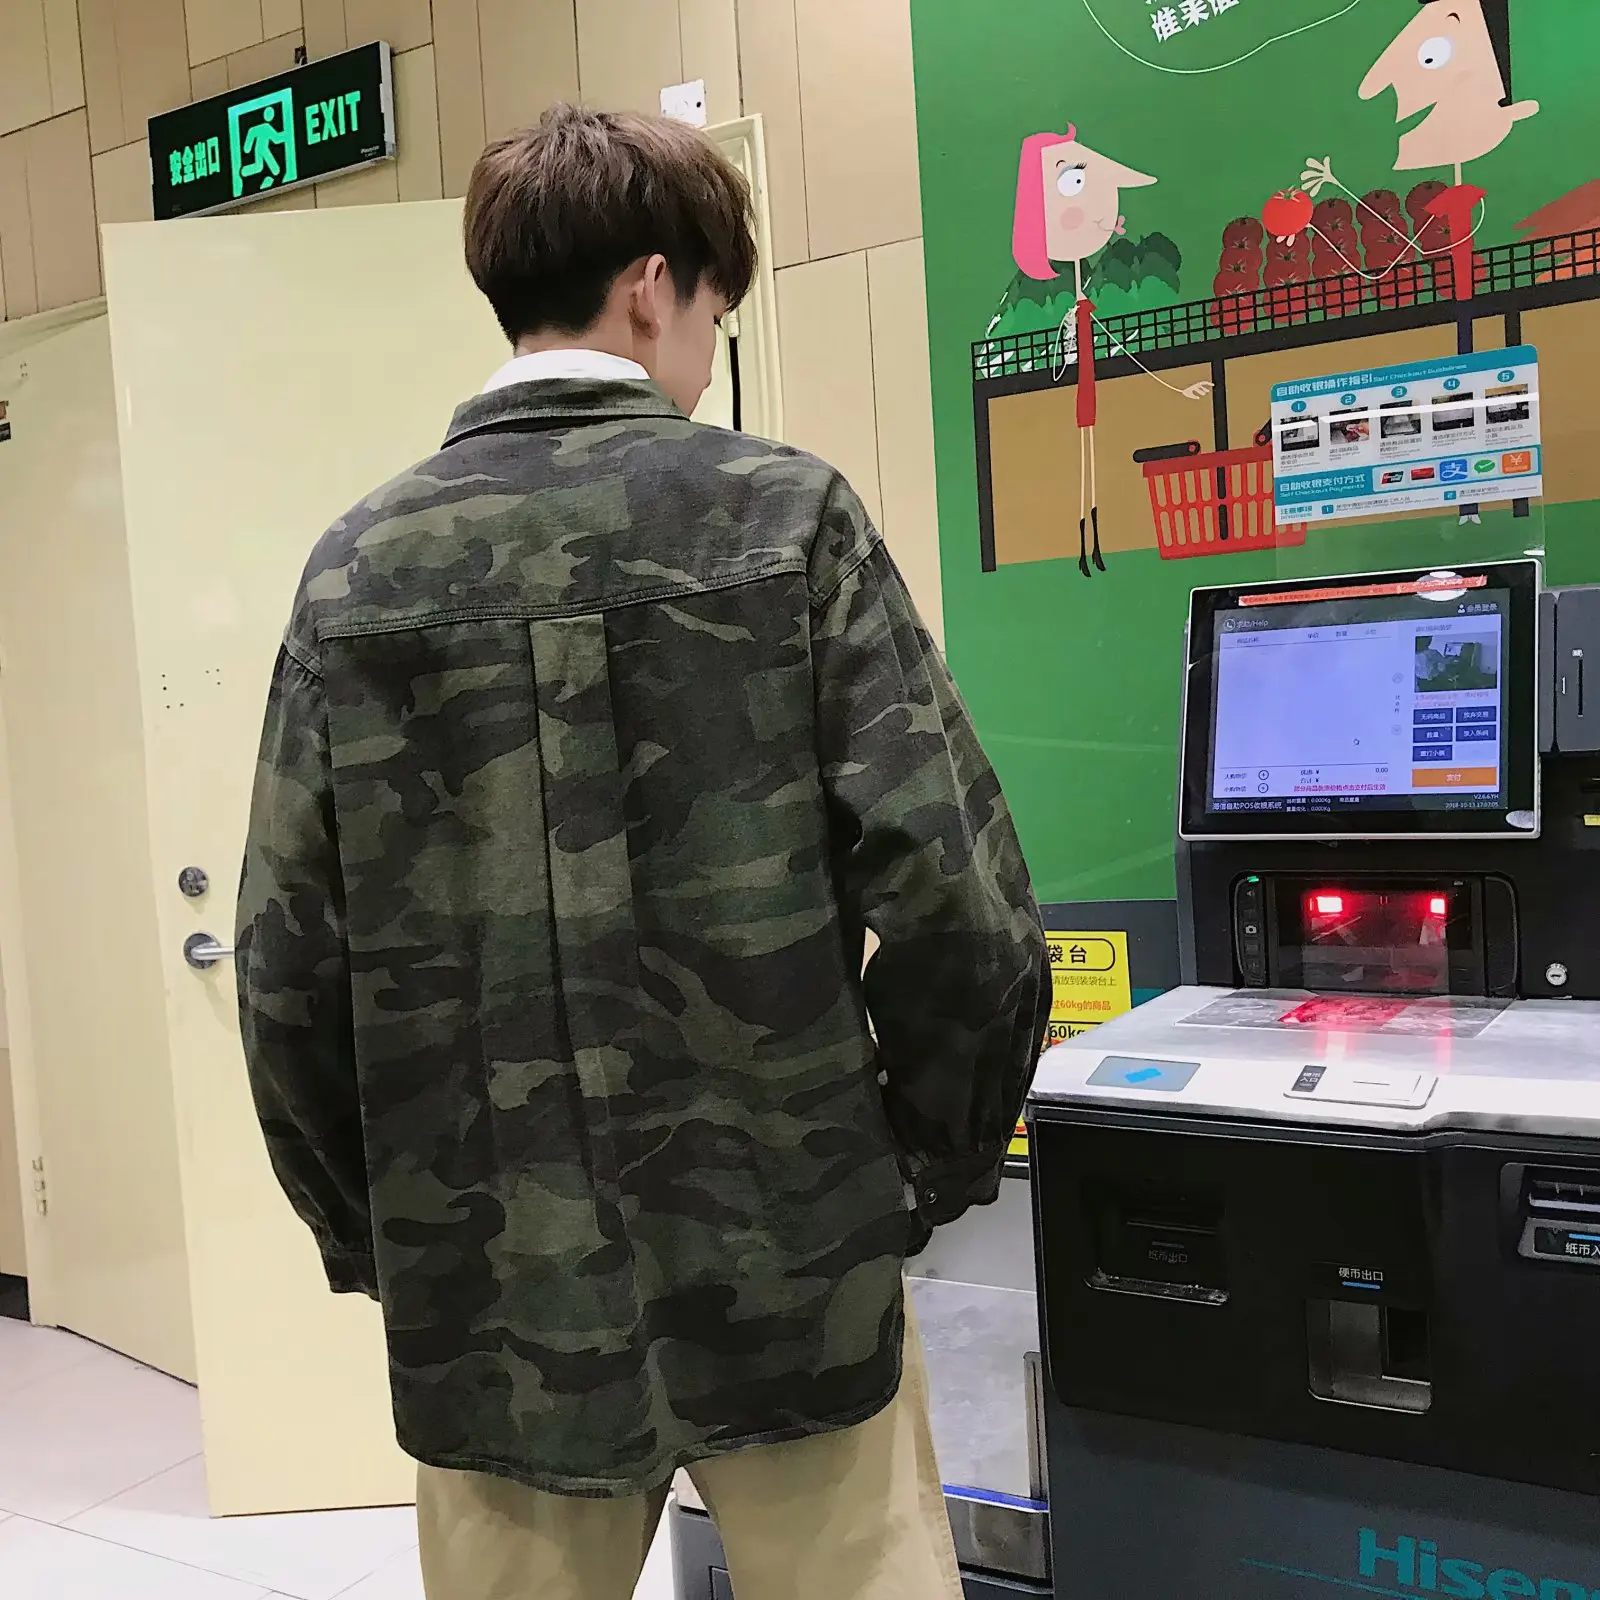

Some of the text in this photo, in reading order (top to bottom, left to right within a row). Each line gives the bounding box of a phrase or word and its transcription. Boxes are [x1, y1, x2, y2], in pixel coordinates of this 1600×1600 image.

[305, 91, 361, 145] EXIT
[169, 137, 220, 186] 安全出口
[1276, 373, 1373, 397] 自助收银操作指引
[1280, 473, 1365, 492] 自助收银支付方式
[1148, 1250, 1188, 1264] 纸币出口
[1338, 1267, 1384, 1282] 硬币出口
[1358, 1527, 1600, 1600] Hisen
